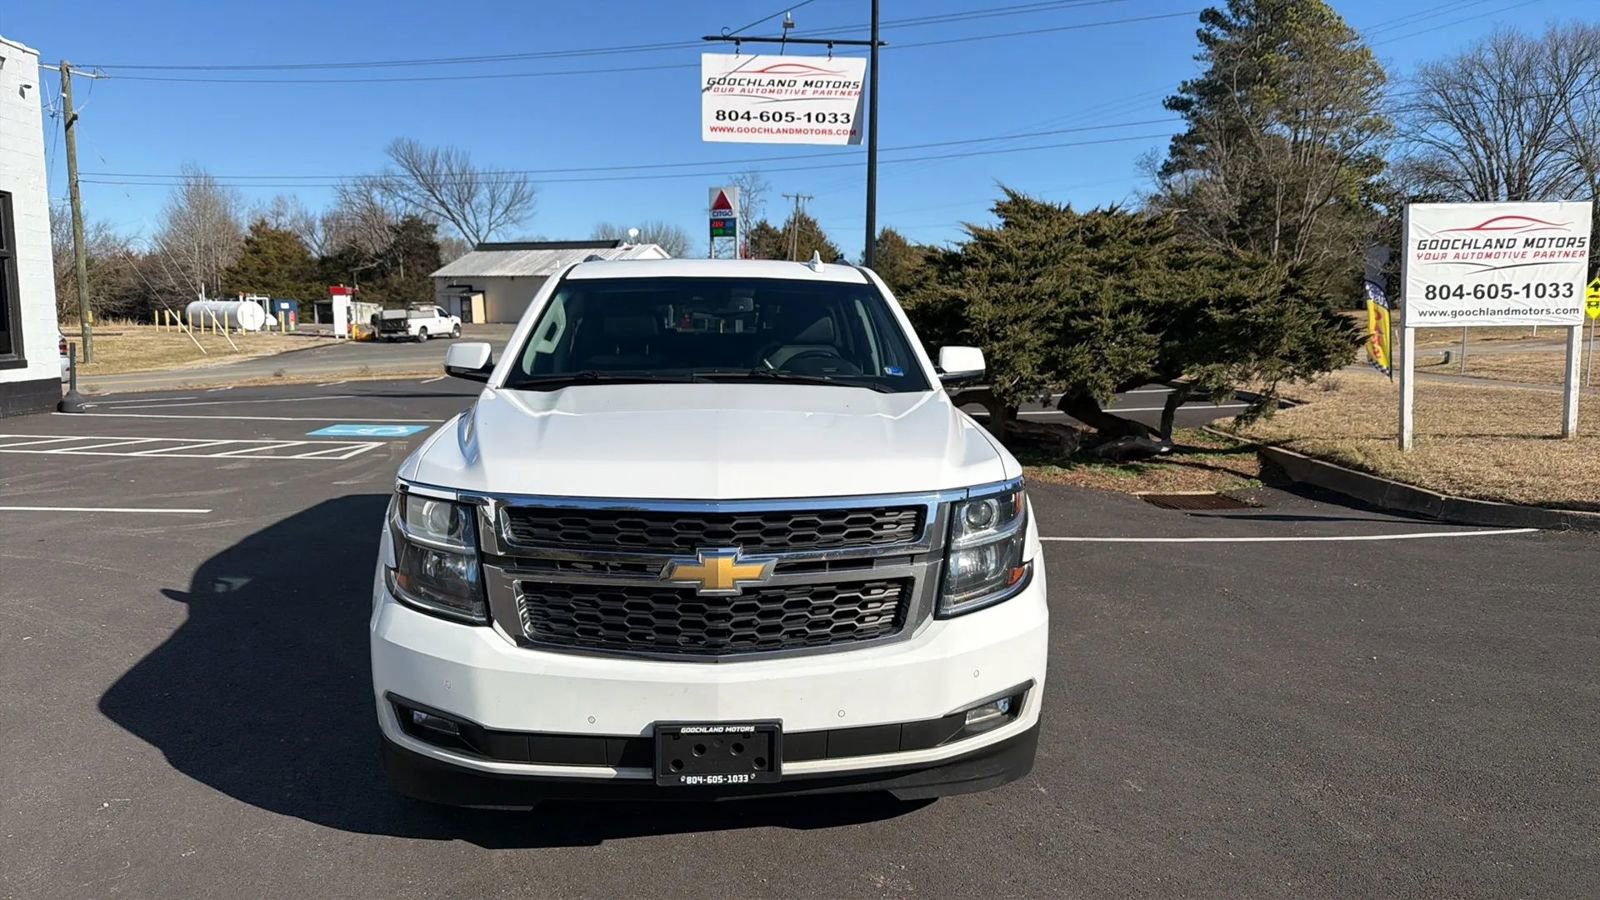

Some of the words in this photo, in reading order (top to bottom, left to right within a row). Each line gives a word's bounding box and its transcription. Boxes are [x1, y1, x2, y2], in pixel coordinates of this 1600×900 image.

[706, 77, 797, 88] GOOCHLAND
[803, 80, 860, 89] MOTORS
[740, 88, 807, 96] AUTOMOTIVE
[715, 109, 851, 124] 804-605-1033
[710, 125, 856, 136] WWW.GOOCHLANDMOTORS.COM
[1417, 238, 1517, 251] GOOCHLAND
[1523, 236, 1587, 248] MOTORS
[1416, 252, 1448, 261] YOUR
[1453, 250, 1528, 260] AUTOMOTIVE
[1533, 250, 1586, 258] PARTNER
[1425, 282, 1574, 300] 804-605-1033
[1418, 307, 1580, 319] www.goochlandmotors.com
[686, 775, 749, 784] 804-605-1033
